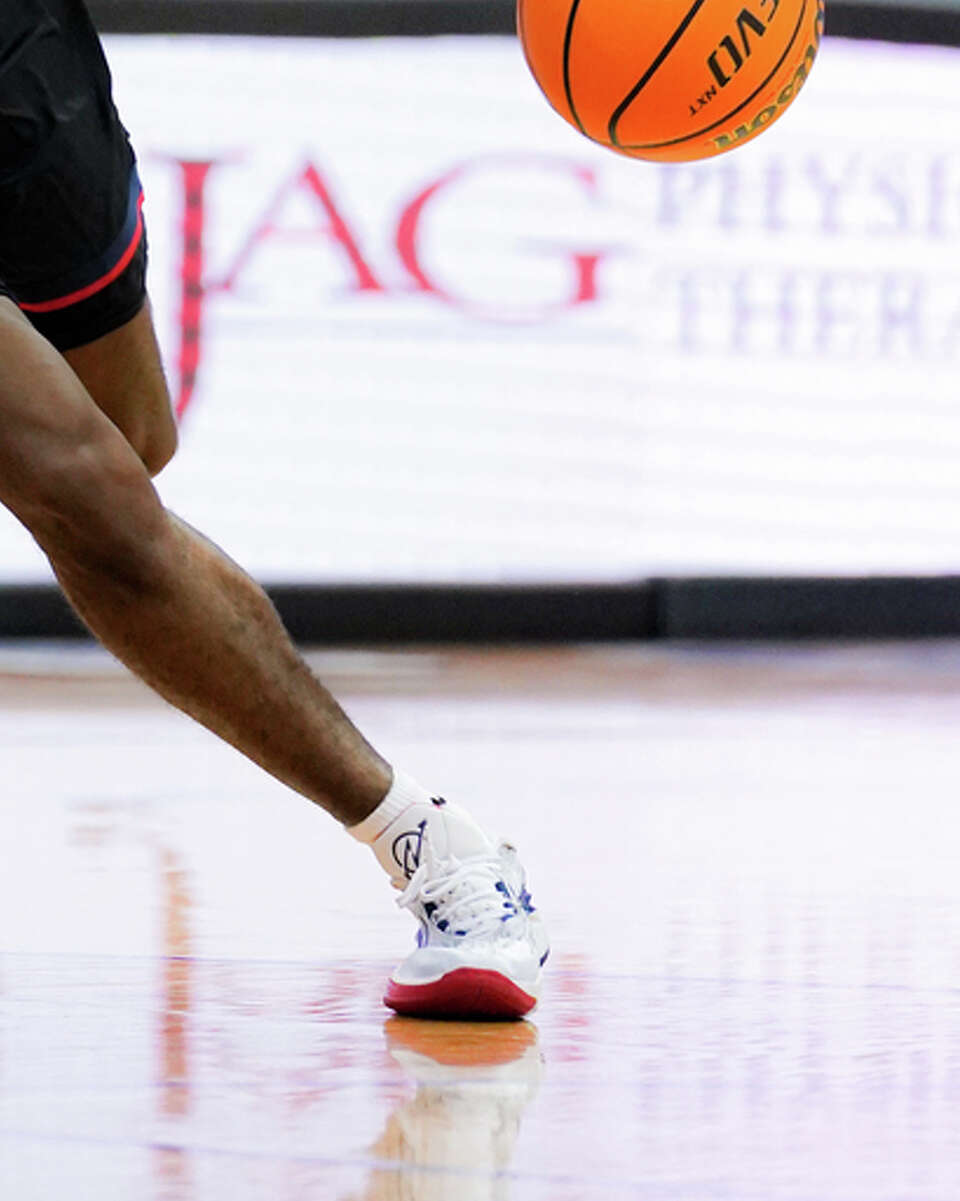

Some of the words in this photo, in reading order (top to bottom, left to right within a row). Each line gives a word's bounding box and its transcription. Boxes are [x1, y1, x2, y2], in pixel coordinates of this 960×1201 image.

[689, 84, 718, 117] NXT
[654, 150, 952, 238] PHYSI
[144, 146, 632, 425] JAG
